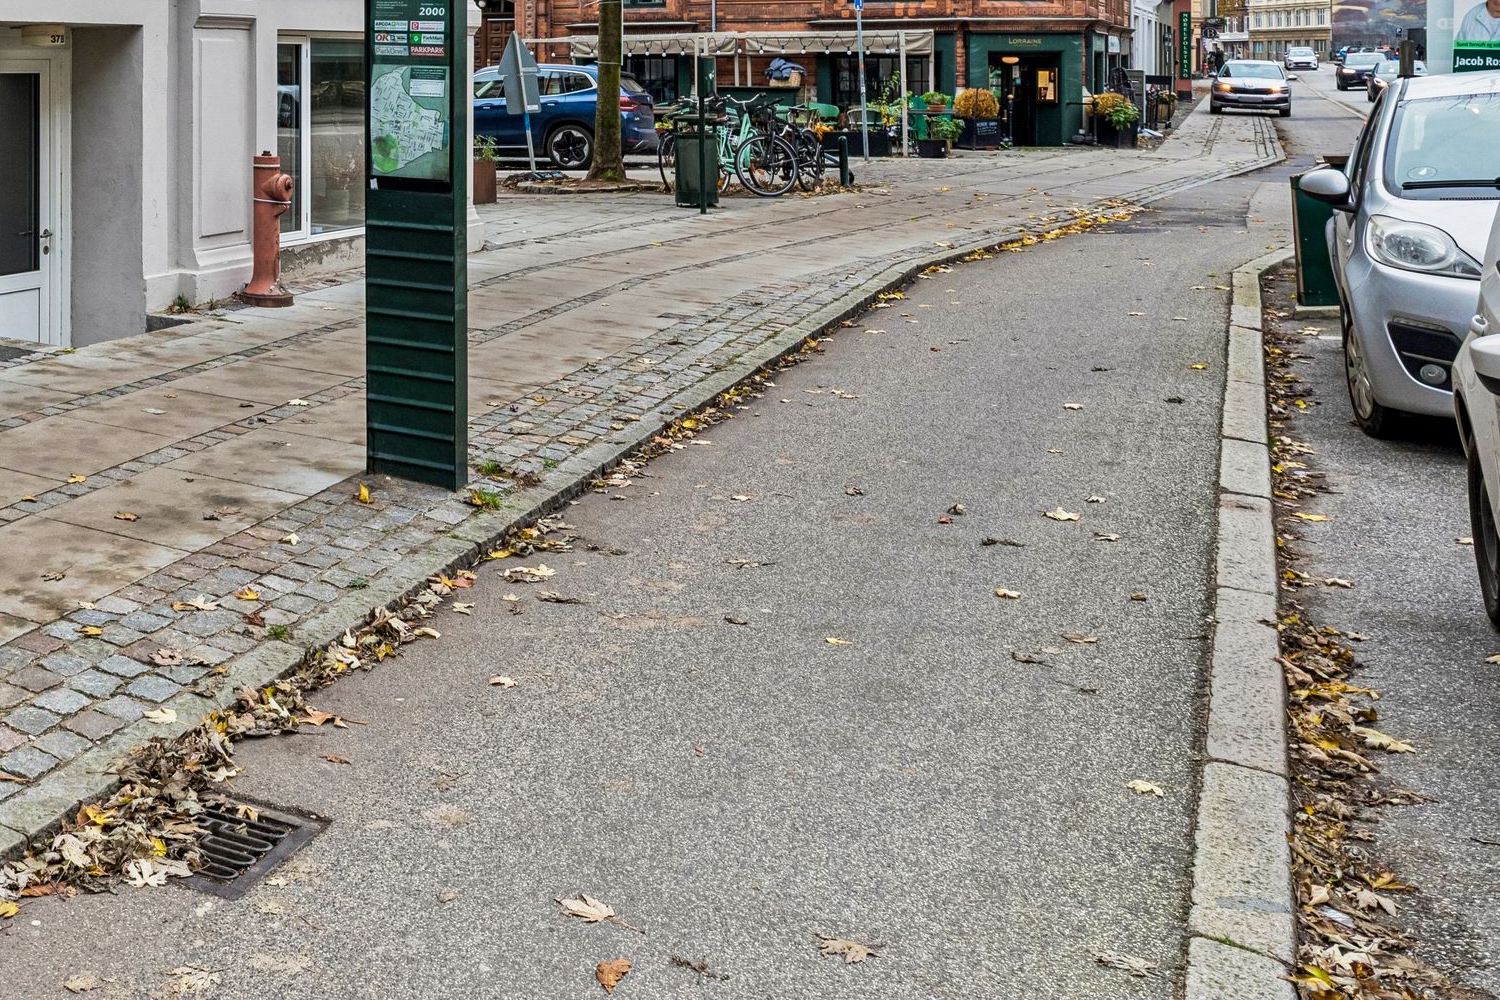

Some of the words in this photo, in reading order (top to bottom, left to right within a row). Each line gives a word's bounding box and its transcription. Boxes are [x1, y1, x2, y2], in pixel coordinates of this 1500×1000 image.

[419, 7, 445, 16] 2000
[50, 34, 65, 43] 37B
[375, 34, 389, 42] OK
[1008, 37, 1043, 45] LORRAINE
[1454, 56, 1484, 68] Jacob
